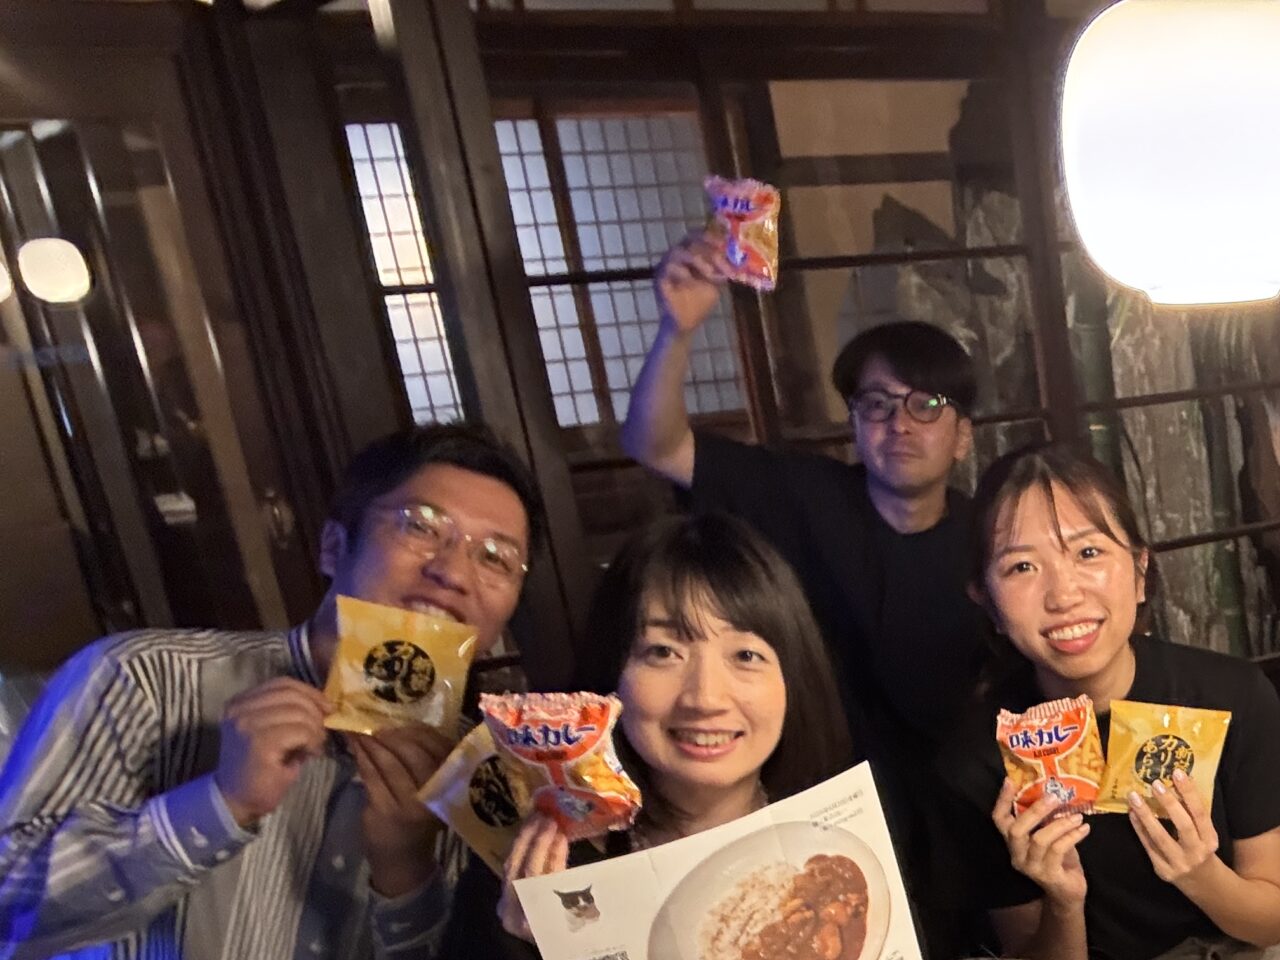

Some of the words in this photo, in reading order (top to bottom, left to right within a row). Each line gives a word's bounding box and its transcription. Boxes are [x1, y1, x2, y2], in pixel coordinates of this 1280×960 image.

[1008, 724, 1079, 749] 味カレー
[1138, 739, 1158, 780] あられ
